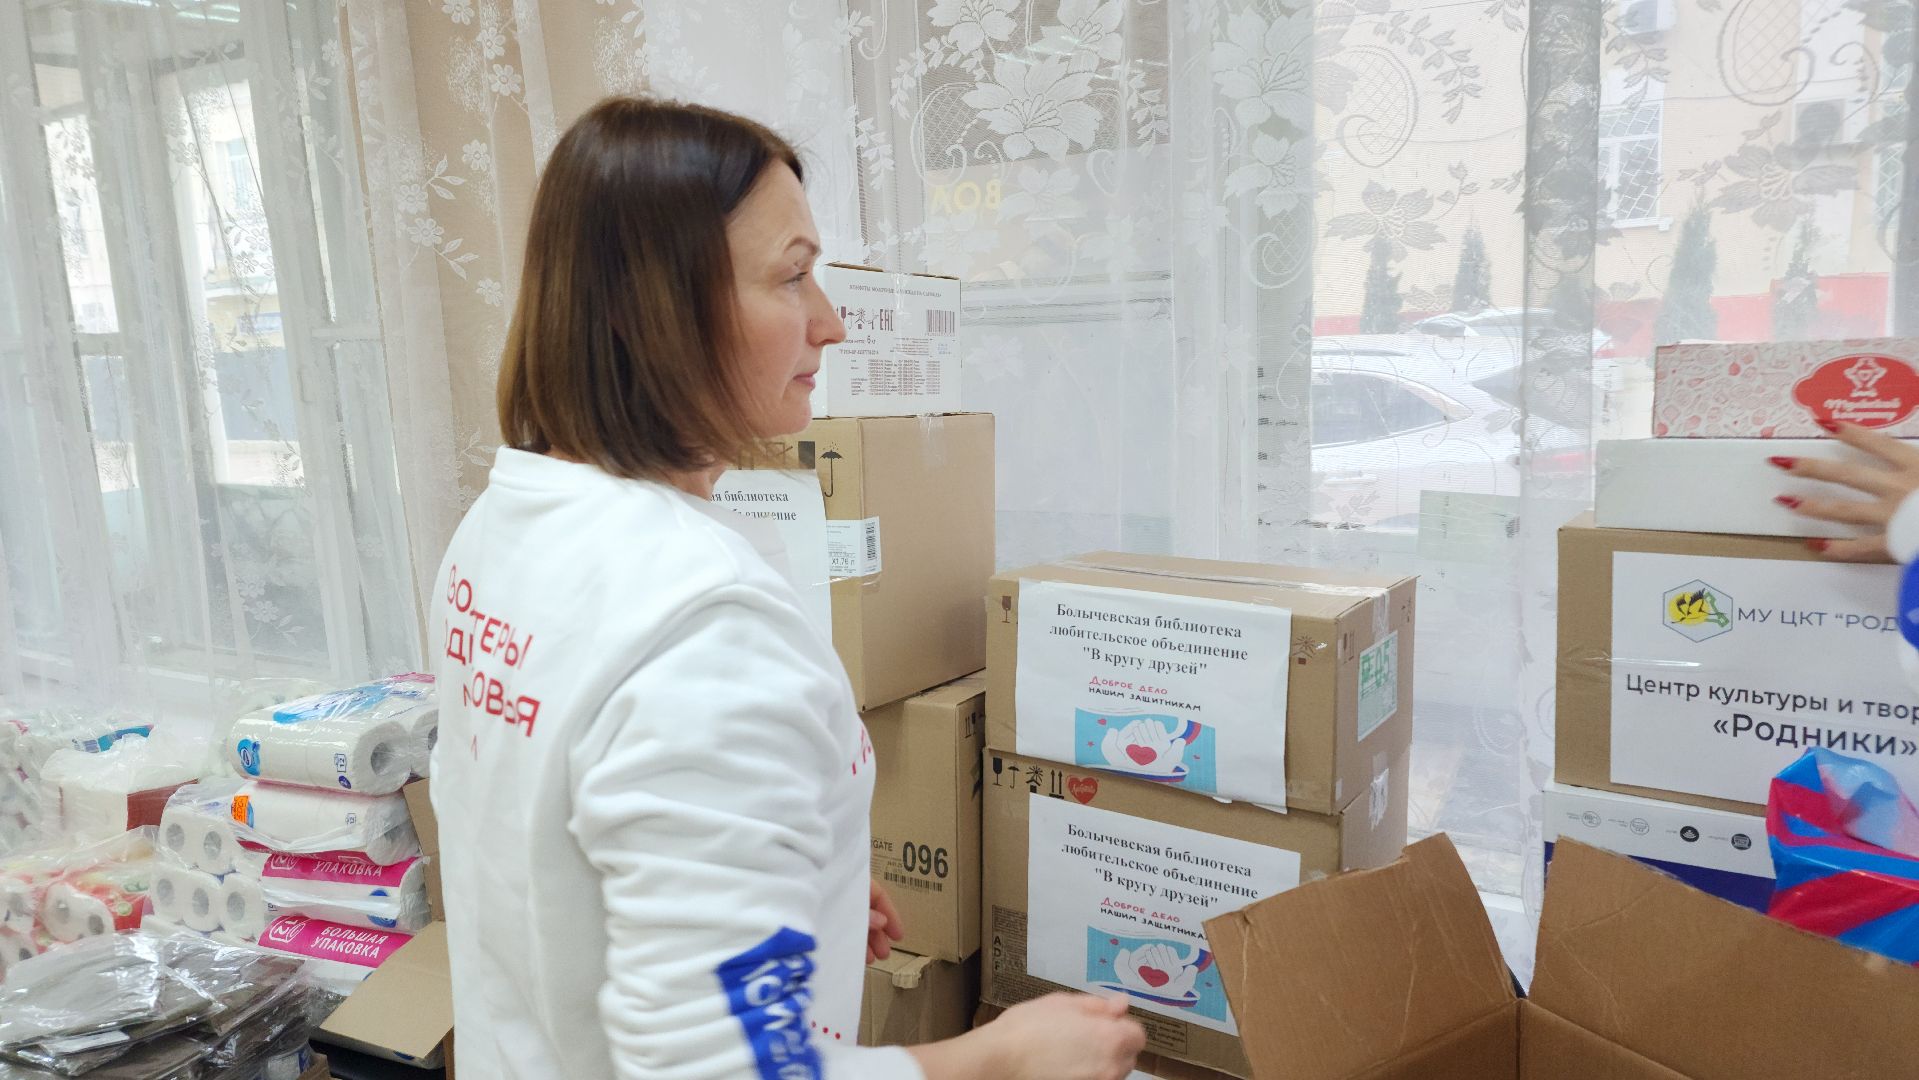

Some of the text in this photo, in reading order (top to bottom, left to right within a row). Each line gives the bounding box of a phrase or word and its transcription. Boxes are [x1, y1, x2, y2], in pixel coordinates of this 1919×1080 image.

[724, 491, 789, 502] библиотека
[1056, 603, 1242, 639] Болычевская библиотека
[1738, 607, 1772, 623] МУ
[1781, 609, 1828, 627] ЦКТ
[1050, 625, 1248, 661] любительское объединение
[1083, 646, 1207, 675] "В кругу друзей"
[1088, 686, 1201, 712] НАШИМ ЗАЩИТНИКАМ
[1626, 674, 1700, 702] Центр
[1709, 685, 1828, 713] культуры
[1838, 699, 1852, 713] и
[1713, 713, 1917, 756] «Родники»
[903, 841, 949, 879] 096
[1067, 823, 1252, 877] Болычевская библиотека
[312, 860, 383, 878] УПАКОВКА
[1061, 844, 1259, 899] любительское объединение
[1095, 868, 1219, 908] "В кругу друзей"
[321, 926, 389, 945] БОЛЬШАЯ
[1100, 907, 1208, 940] НАШИМ ЗАЩИТНИКА
[310, 936, 380, 959] УПАКОВКА
